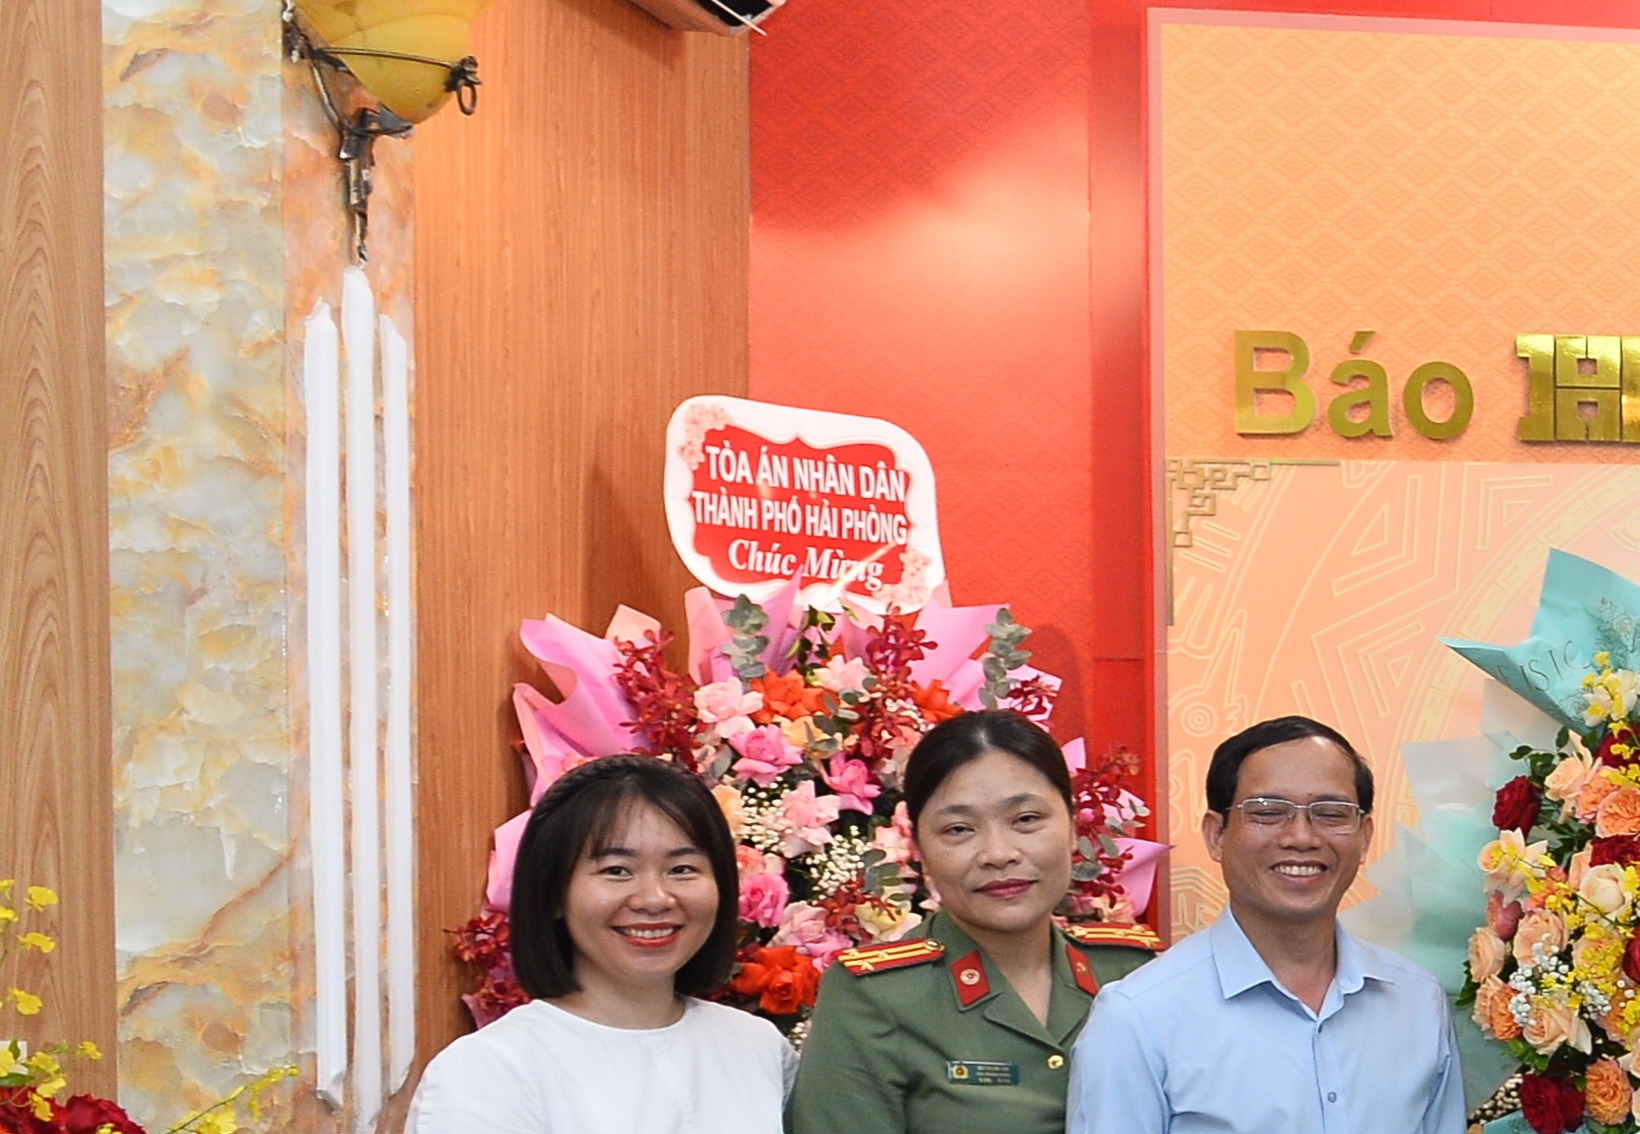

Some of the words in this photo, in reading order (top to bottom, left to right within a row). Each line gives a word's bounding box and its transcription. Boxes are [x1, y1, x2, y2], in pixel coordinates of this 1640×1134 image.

[1233, 322, 1474, 440] Báo
[705, 440, 753, 484] TÒA
[757, 445, 788, 488] ÁN
[793, 454, 854, 496] NHÂN
[859, 461, 905, 502] DÂN
[692, 486, 757, 530] THÀNH
[761, 495, 800, 534] PHỐ
[805, 499, 838, 538] HẢI
[841, 504, 907, 545] PHÒNG
[728, 539, 797, 575] Chúc
